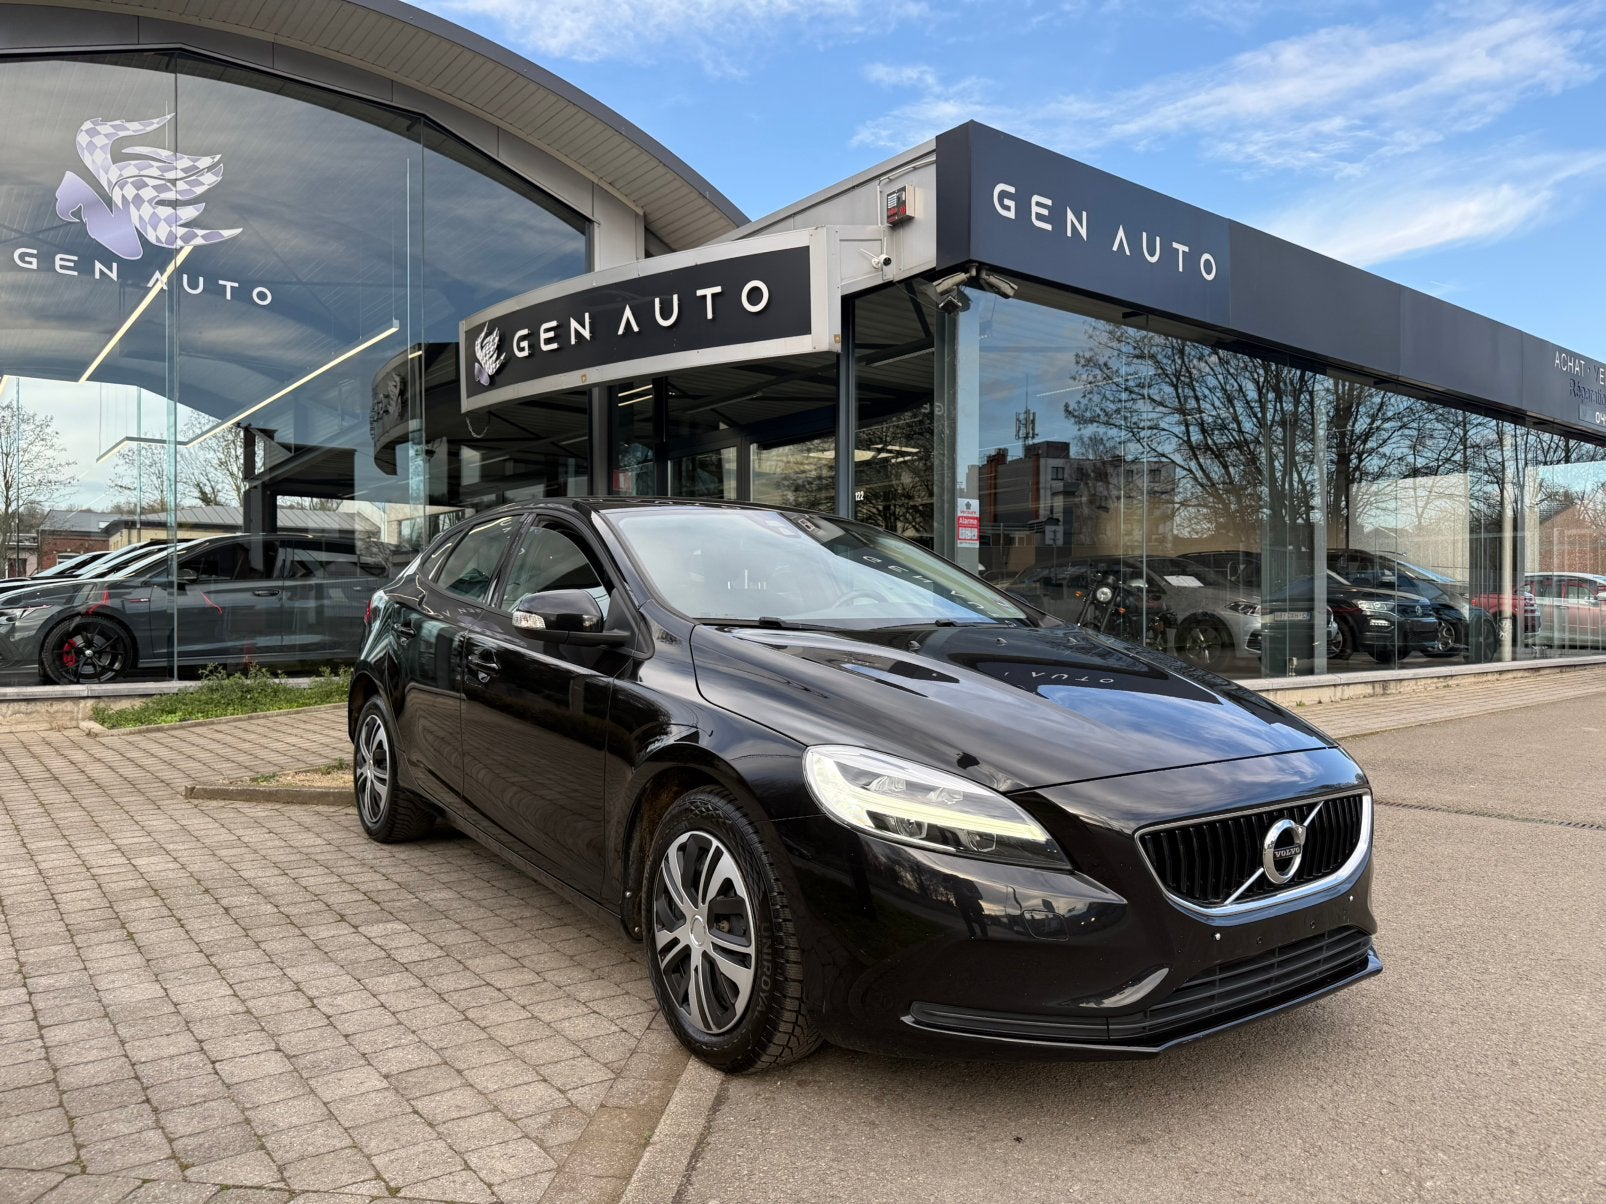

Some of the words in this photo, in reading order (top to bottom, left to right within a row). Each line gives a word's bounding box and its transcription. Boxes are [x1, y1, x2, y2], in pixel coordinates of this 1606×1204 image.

[993, 183, 1087, 242] GEN
[1112, 225, 1216, 281] AUTO
[13, 248, 117, 282] GEN
[147, 270, 272, 306] AUTO
[512, 312, 592, 359] GEN
[617, 279, 769, 336] AUTO
[1554, 351, 1585, 377] ACHAT
[1274, 847, 1300, 858] VOLVO
